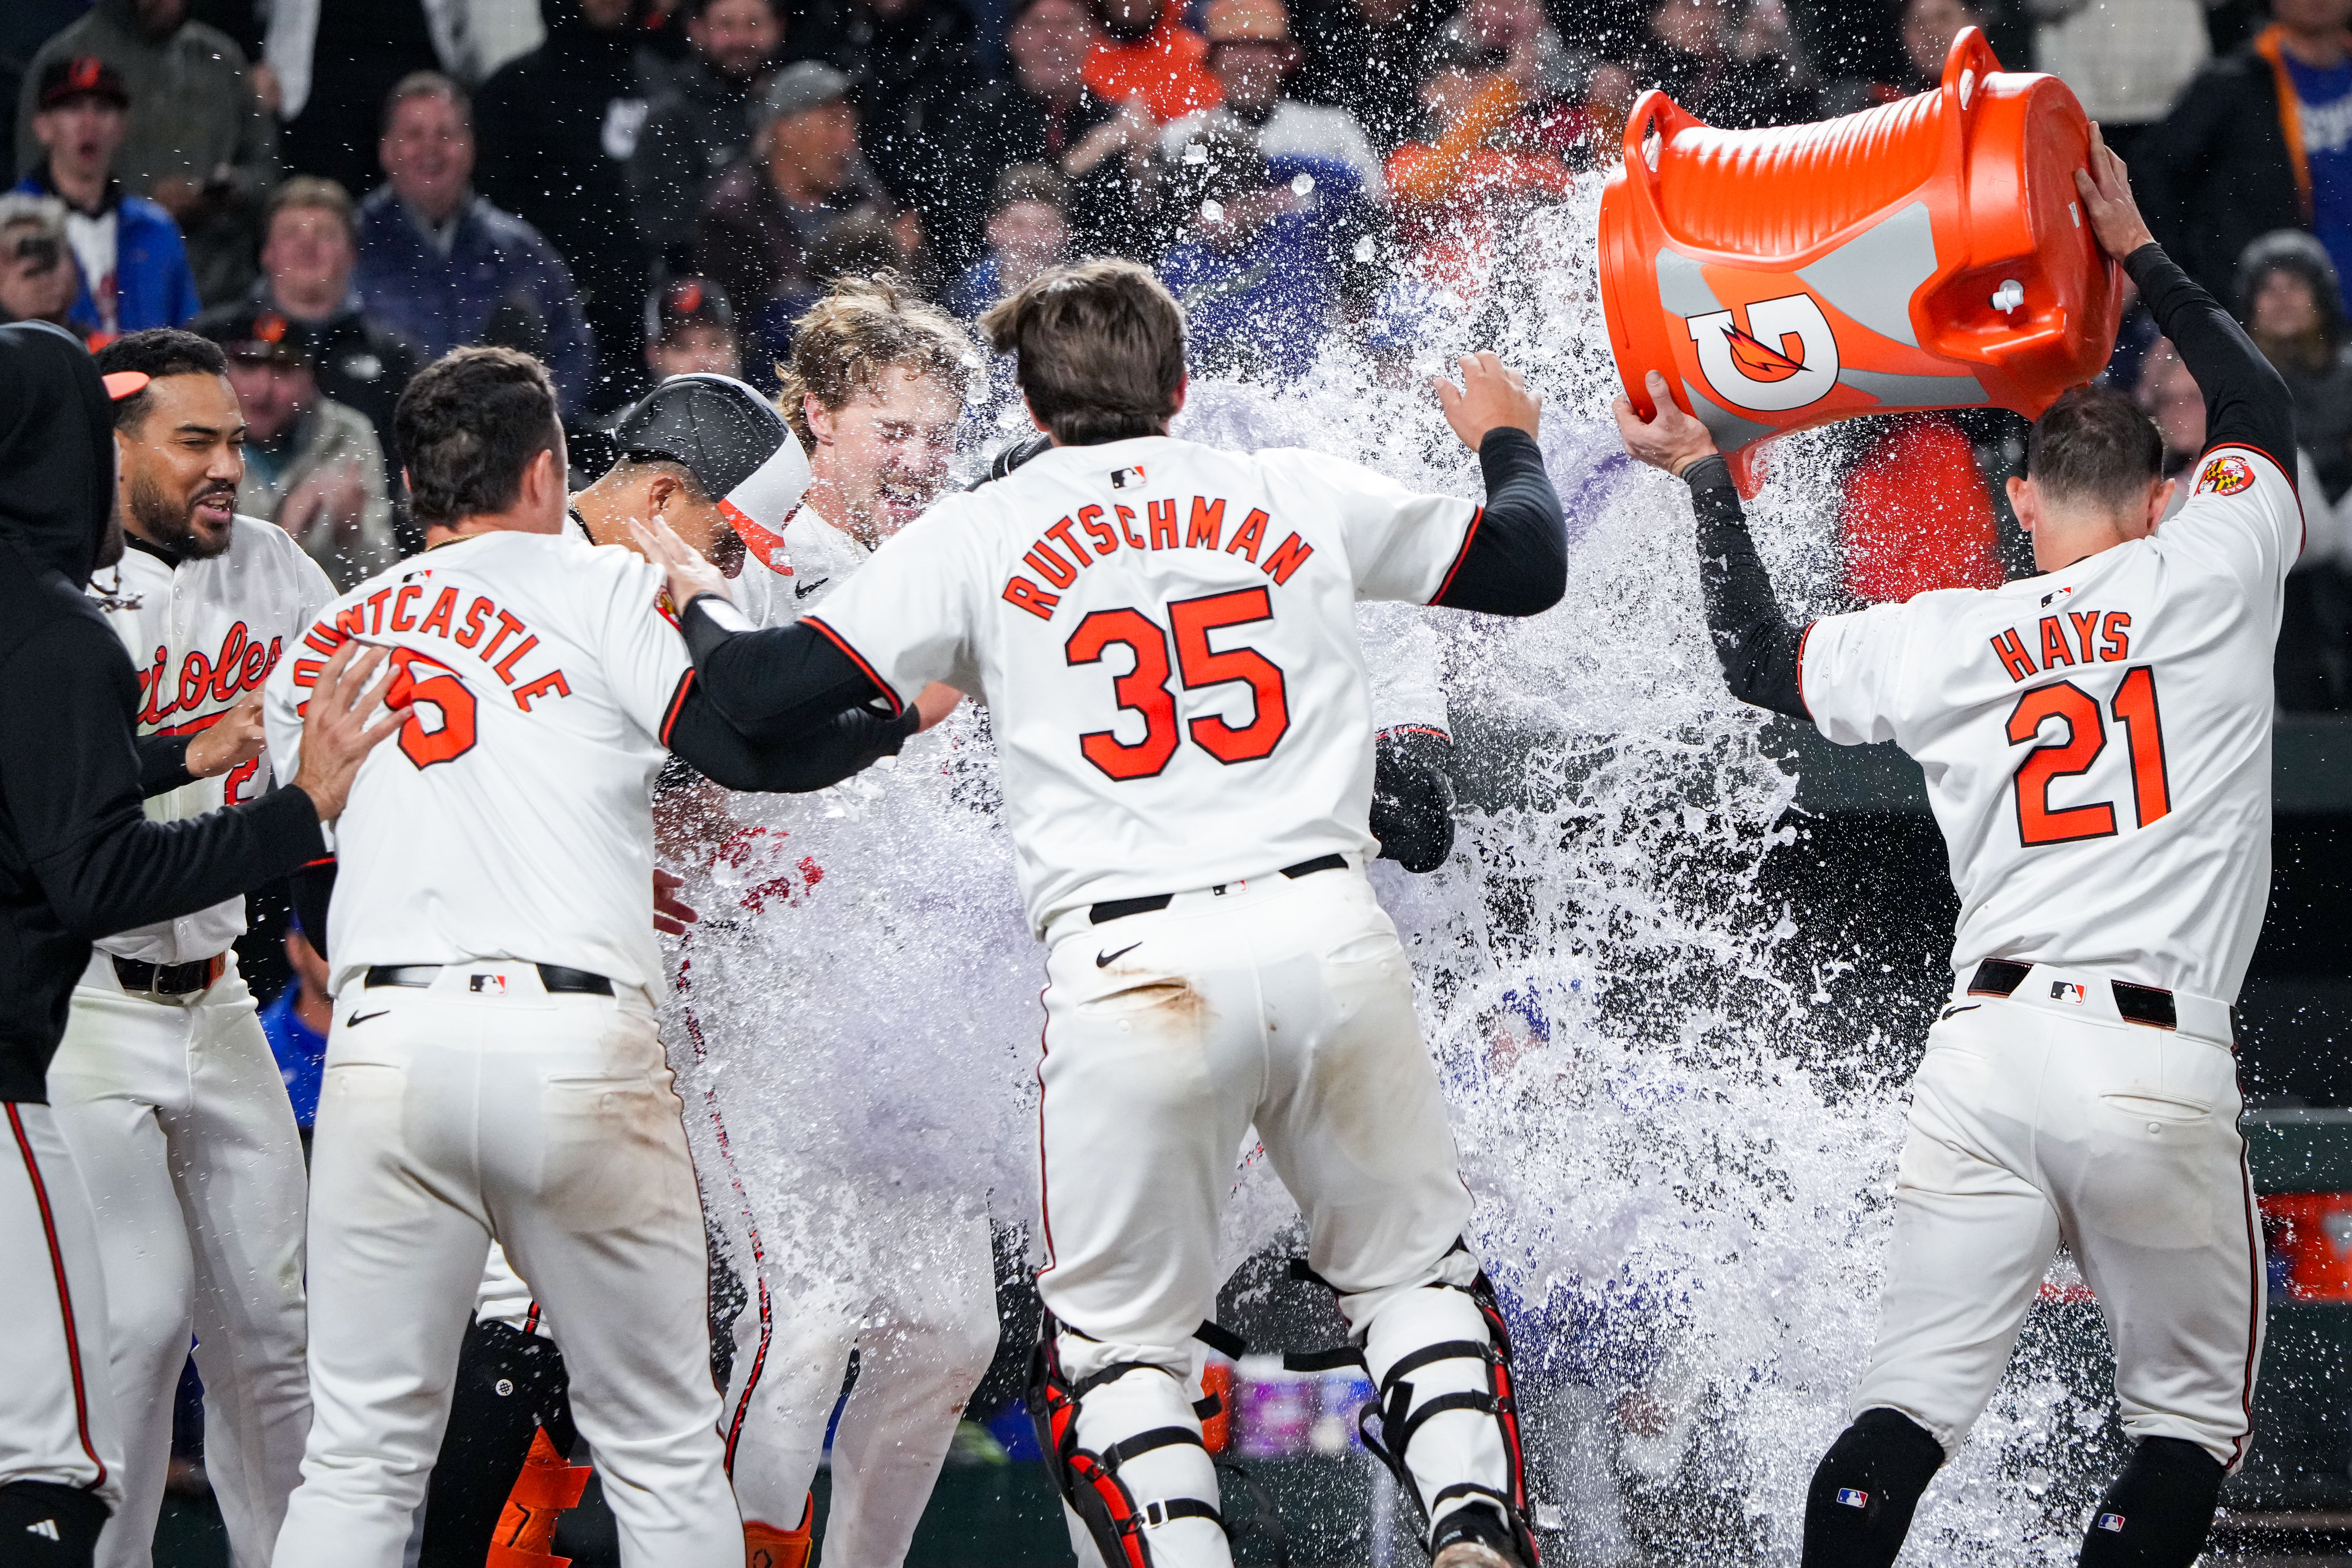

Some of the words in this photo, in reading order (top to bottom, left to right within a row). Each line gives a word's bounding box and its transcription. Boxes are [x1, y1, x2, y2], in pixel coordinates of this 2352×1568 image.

[1002, 495, 1314, 621] RUTSCHMAN
[293, 585, 572, 718] OUNTCASTLE
[1064, 585, 1291, 782] 35
[1989, 610, 2132, 684] HAYS
[2005, 664, 2172, 849] 21
